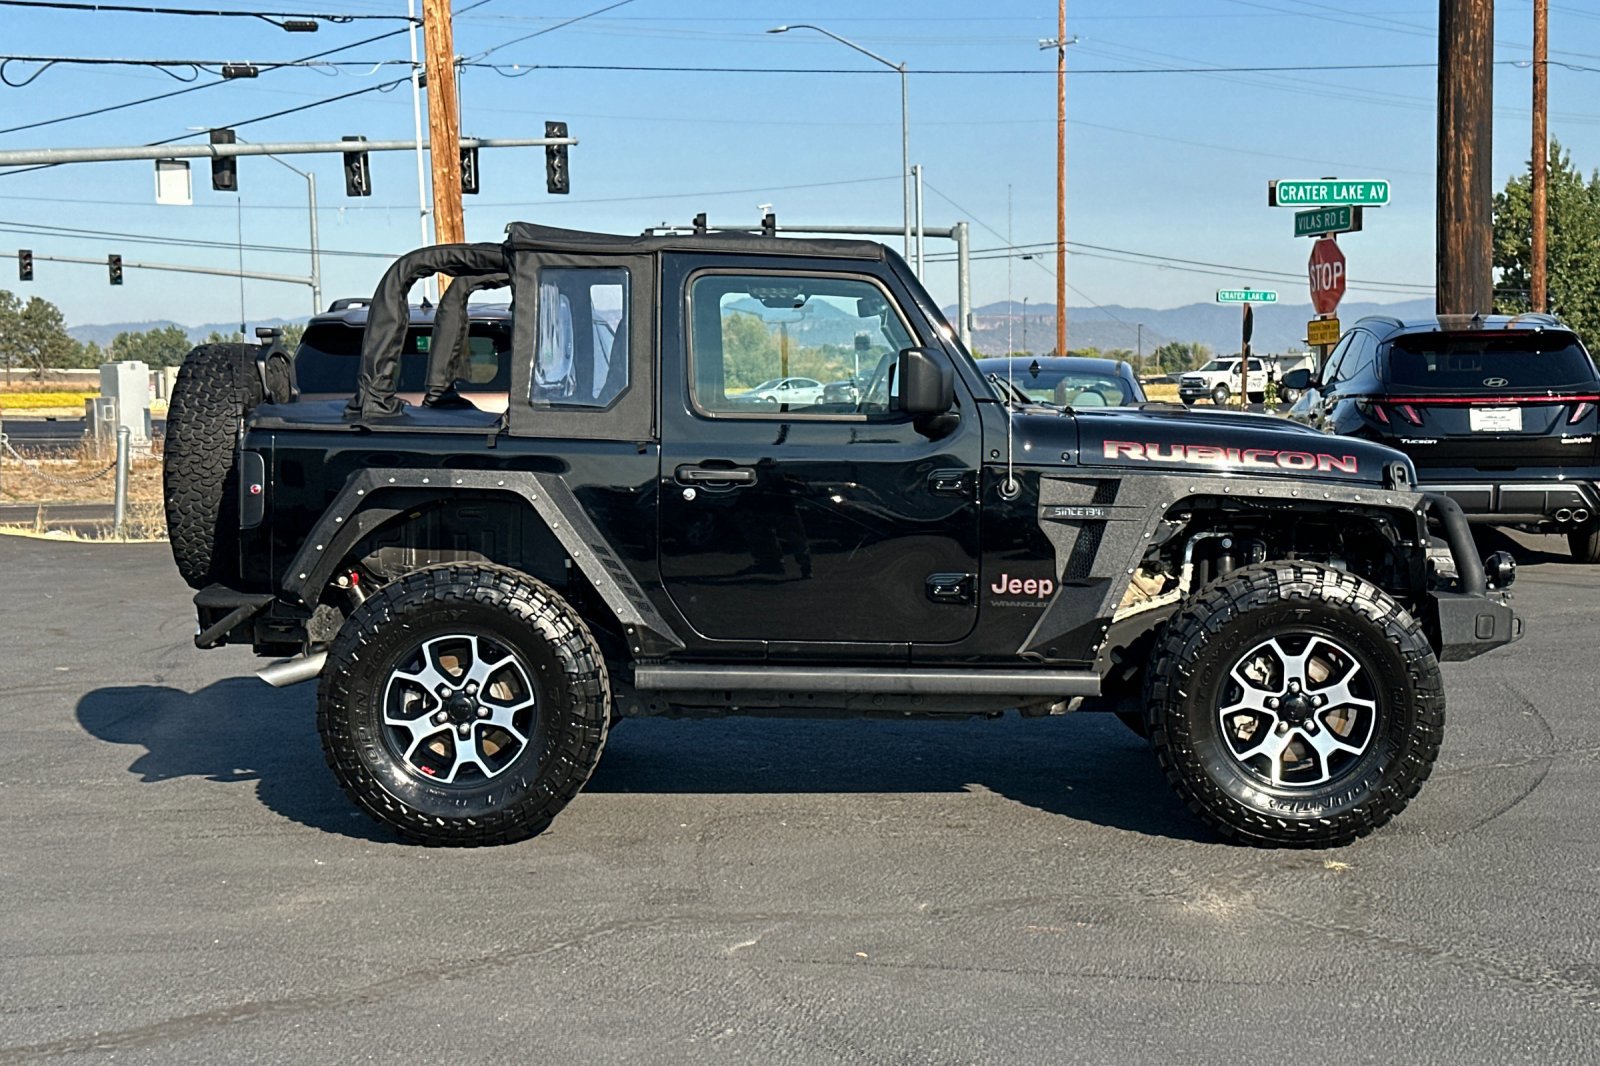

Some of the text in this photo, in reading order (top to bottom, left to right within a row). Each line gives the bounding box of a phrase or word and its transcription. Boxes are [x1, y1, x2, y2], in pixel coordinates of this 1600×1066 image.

[1280, 184, 1385, 201] CRATER LAKE AV
[1298, 214, 1321, 230] VILAS
[1325, 212, 1336, 227] RD
[1310, 261, 1343, 292] STOP
[1221, 291, 1245, 300] CRATER
[1103, 440, 1358, 474] RUBICON
[1055, 507, 1083, 516] SINCE
[991, 573, 1053, 599] Jeep
